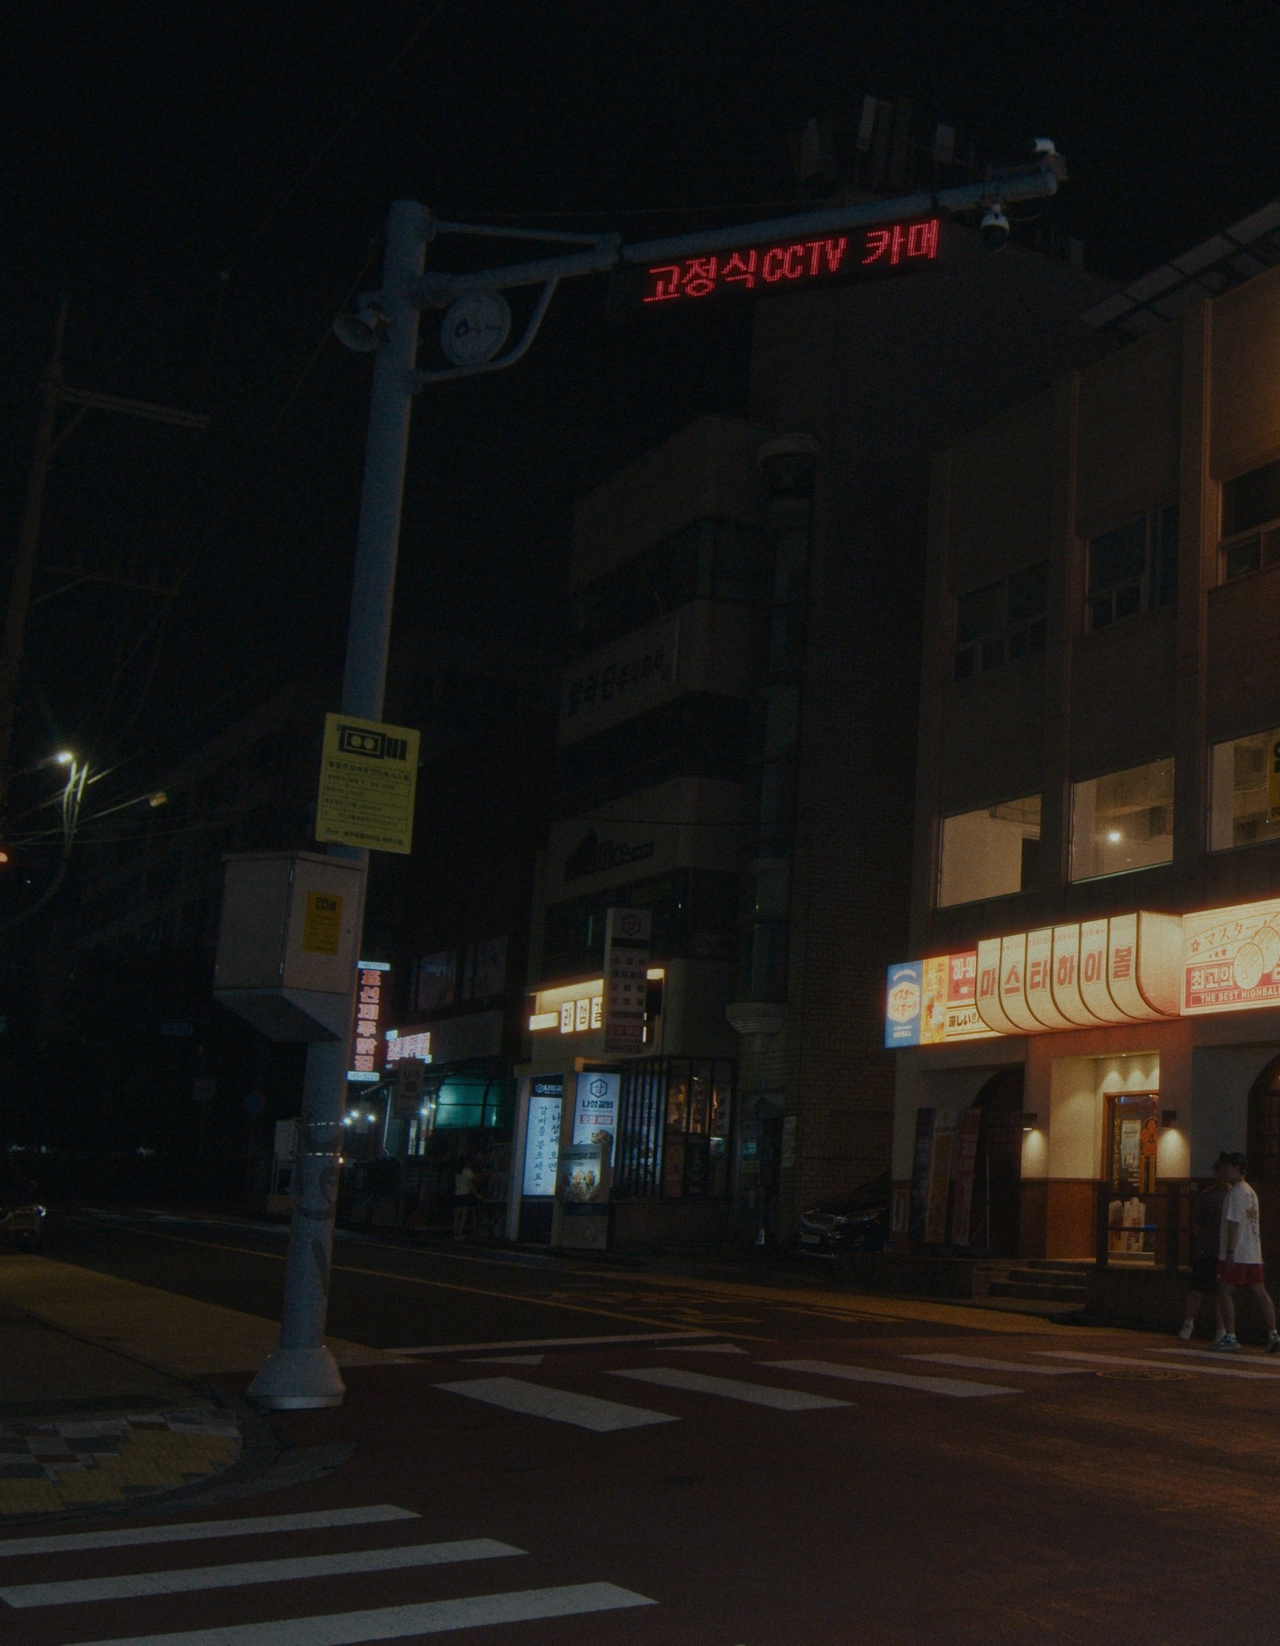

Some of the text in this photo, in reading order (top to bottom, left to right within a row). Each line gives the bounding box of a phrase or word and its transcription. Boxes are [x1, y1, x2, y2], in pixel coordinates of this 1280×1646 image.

[642, 218, 940, 302] 고정식CCTV 카메
[979, 945, 1133, 998] 마스타하이볼
[1191, 966, 1234, 991] 최고의
[1201, 993, 1217, 1004] THE
[1219, 989, 1239, 1002] BEST
